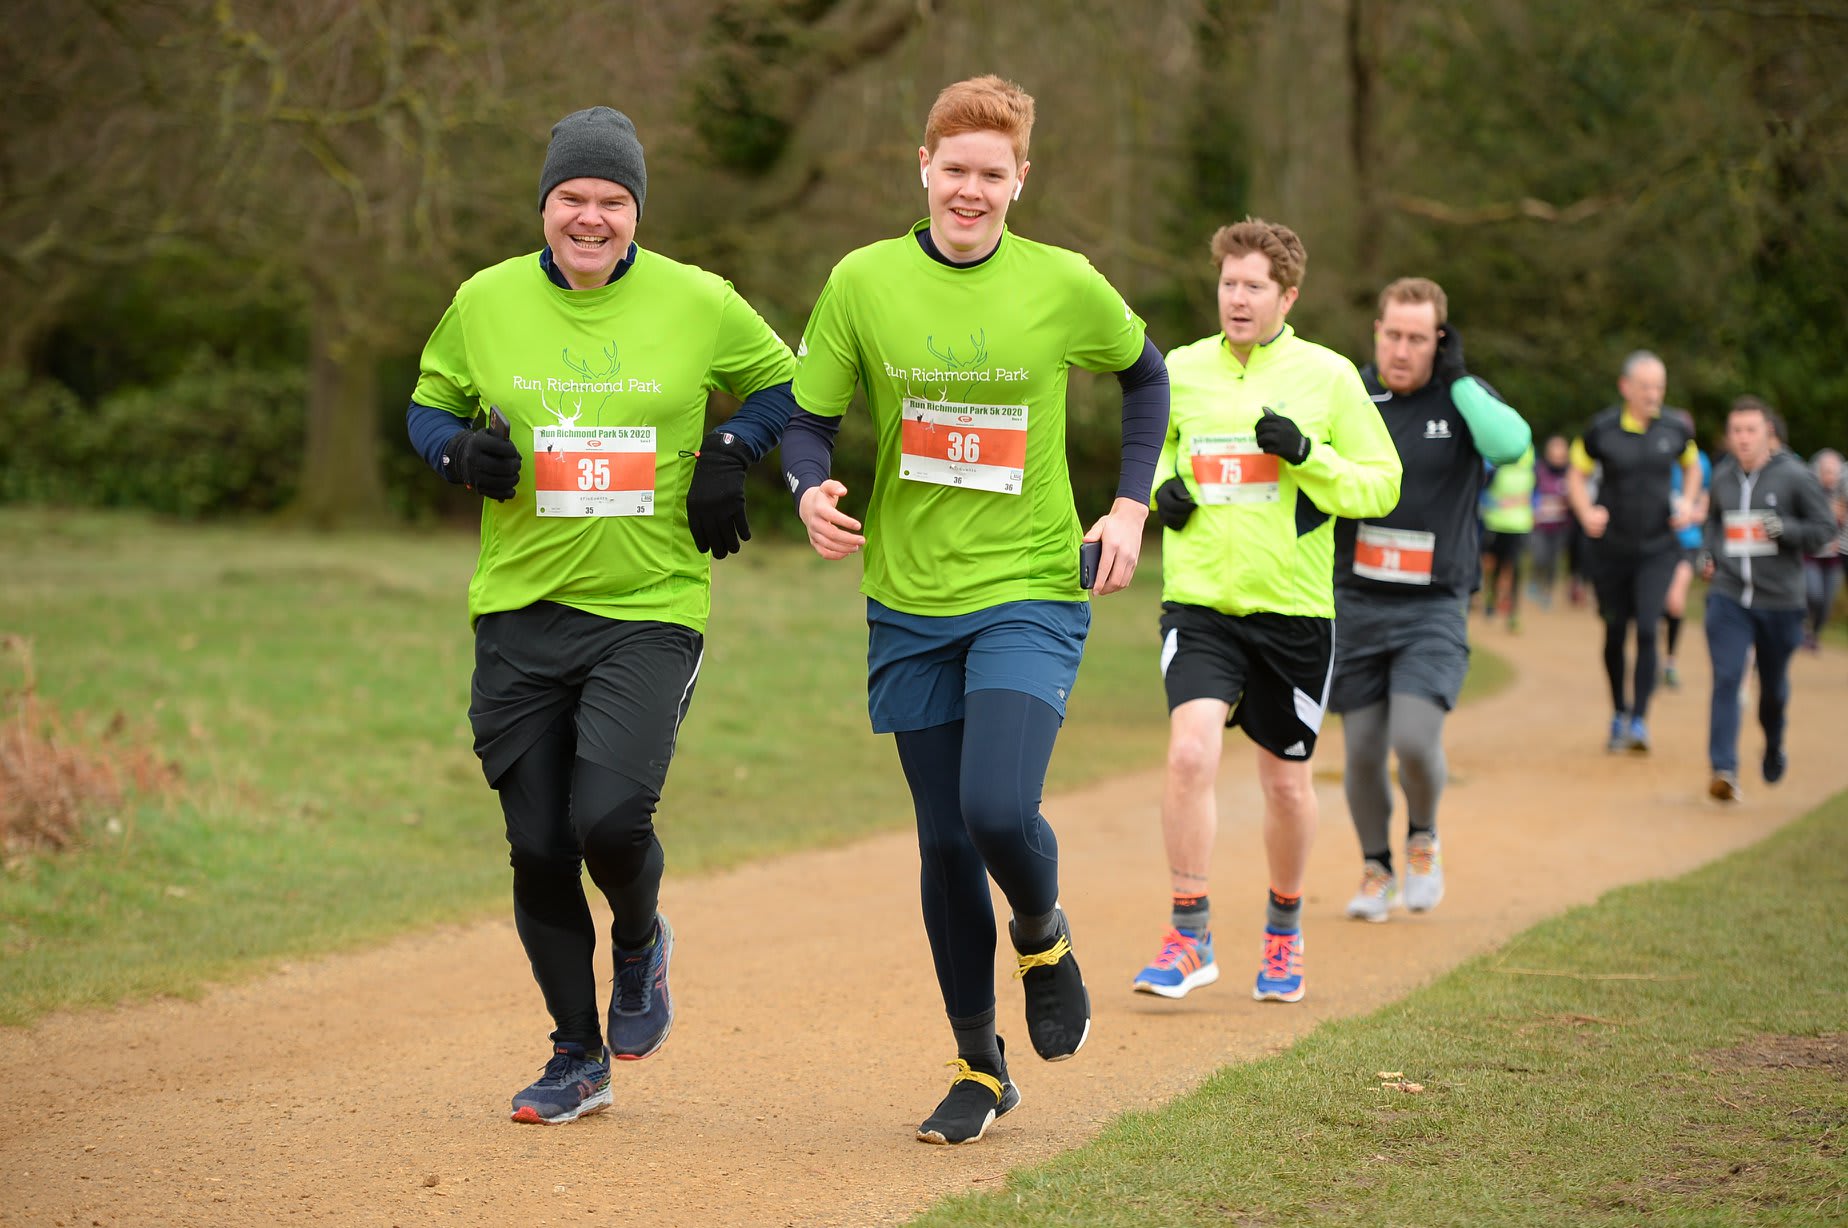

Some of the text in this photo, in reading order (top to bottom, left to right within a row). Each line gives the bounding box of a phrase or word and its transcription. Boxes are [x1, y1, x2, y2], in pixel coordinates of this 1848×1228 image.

[884, 362, 1030, 382] Run Richmond Park
[513, 375, 662, 393] Run Richmond Park
[909, 400, 1023, 417] Run Richmond Park 5k 2020
[540, 429, 651, 439] Run Richmond Park 5k 2020
[947, 431, 980, 463] 36
[577, 458, 611, 491] 35
[1219, 457, 1242, 485] 75
[953, 476, 962, 484] 36
[1004, 483, 1013, 491] 36
[585, 506, 594, 514] 35
[636, 505, 646, 514] 35
